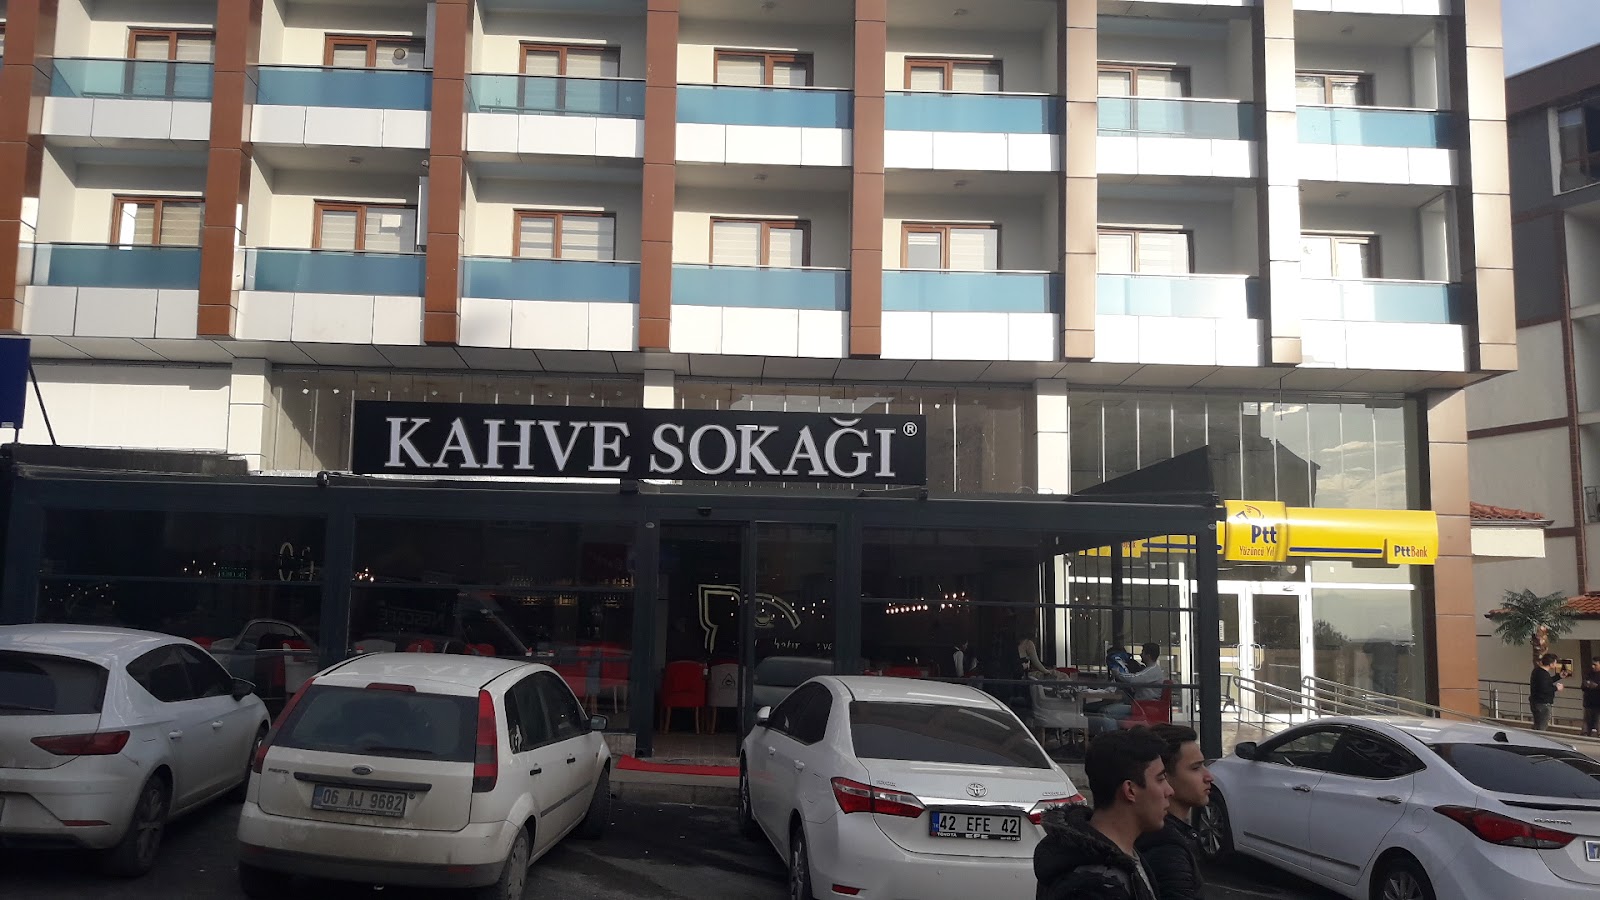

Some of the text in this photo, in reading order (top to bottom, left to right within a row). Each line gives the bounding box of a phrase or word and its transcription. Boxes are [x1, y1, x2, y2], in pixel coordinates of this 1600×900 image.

[384, 416, 631, 472] KAHVE
[649, 417, 897, 478] SOKAĞI
[1251, 524, 1277, 544] Ptt
[1239, 545, 1265, 556] Yüzüncü
[1394, 545, 1428, 557] PttBank
[323, 788, 403, 811] 06 AJ 9682
[940, 815, 1017, 834] 42 EFE 42
